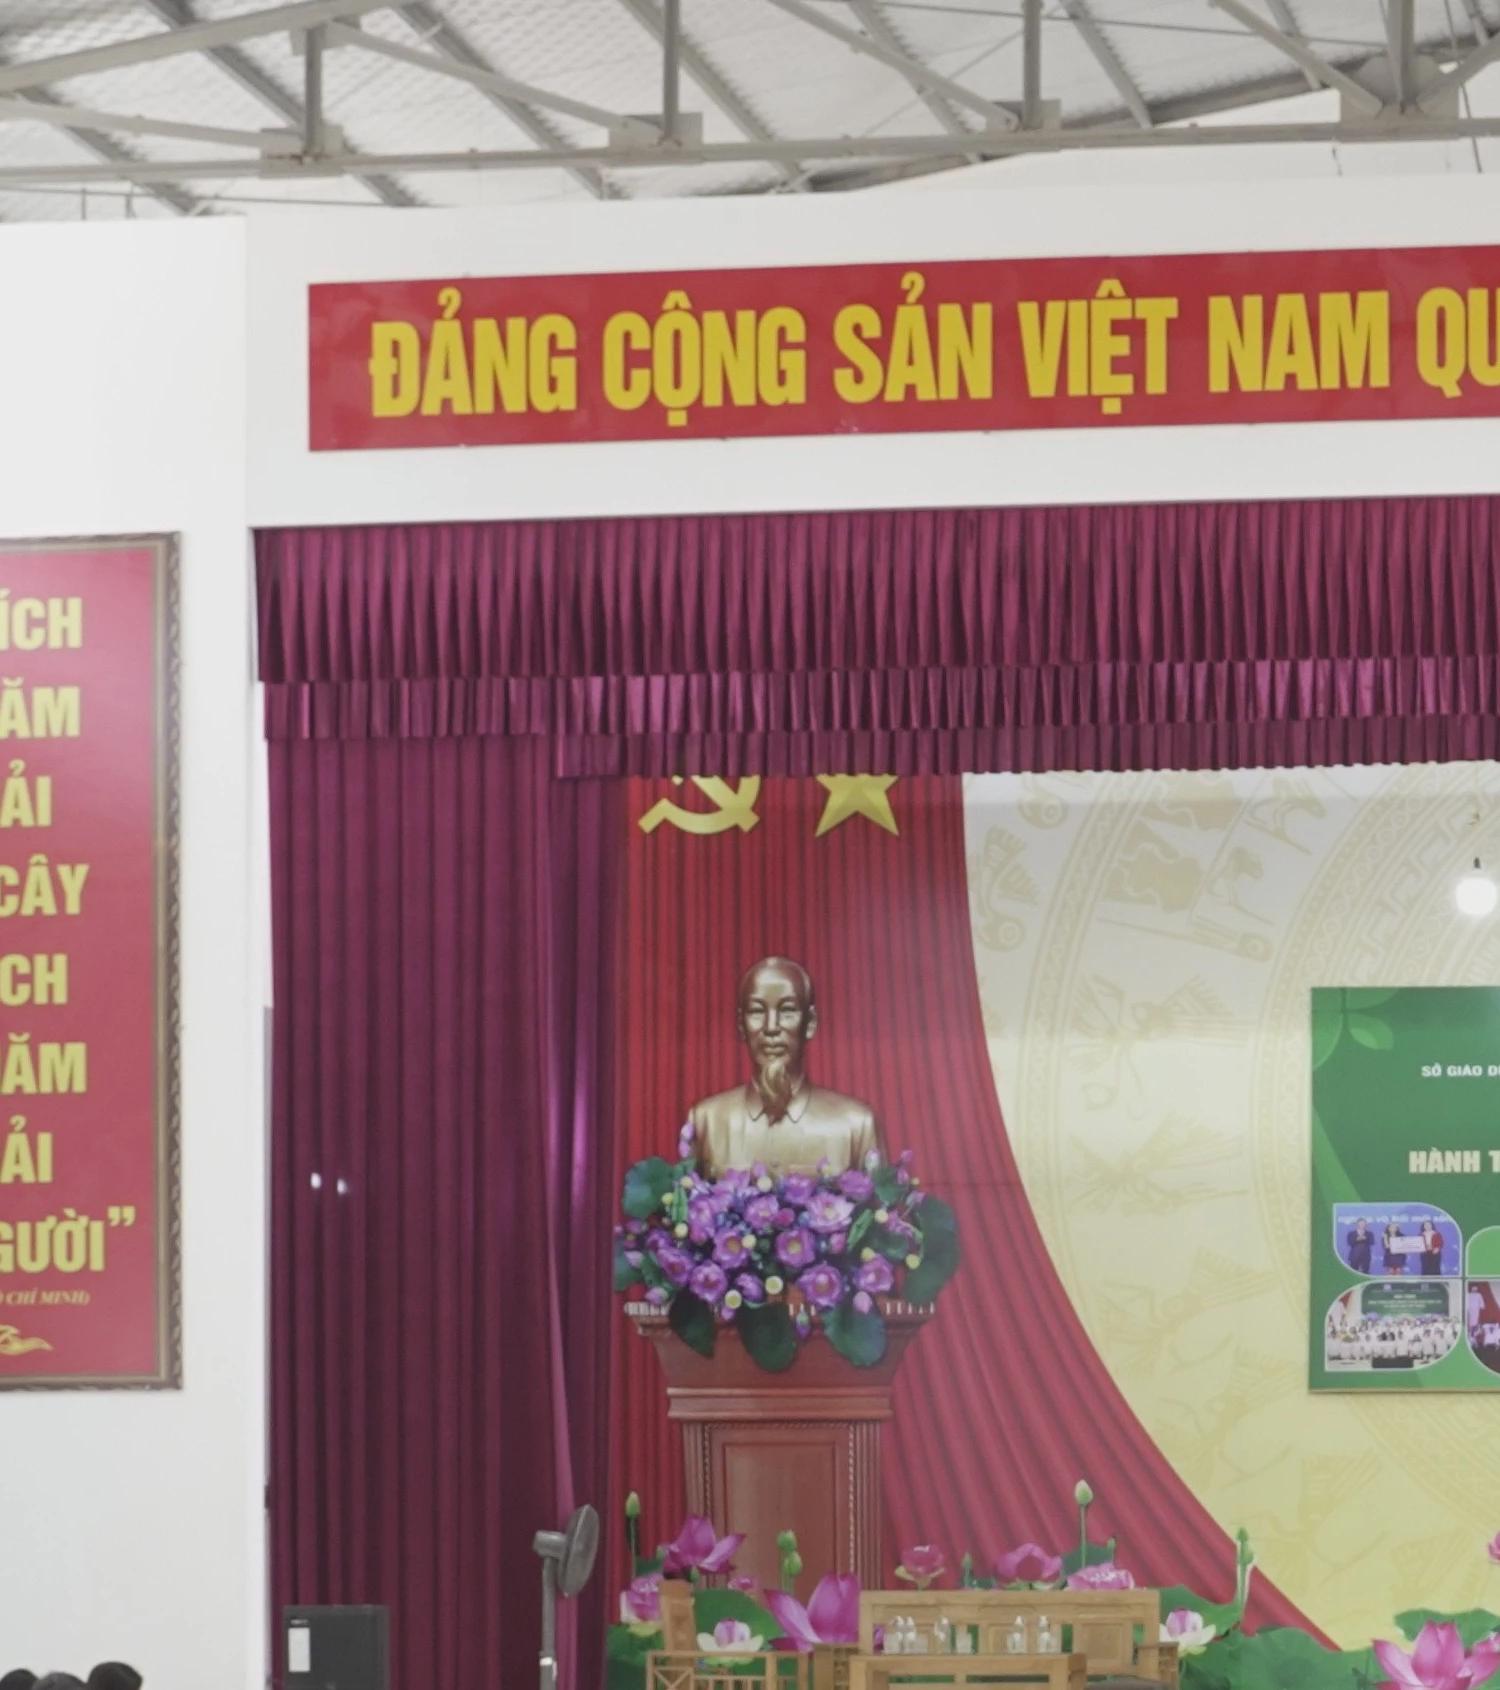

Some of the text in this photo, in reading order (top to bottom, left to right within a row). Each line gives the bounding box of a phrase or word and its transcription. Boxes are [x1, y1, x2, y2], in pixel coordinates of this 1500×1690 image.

[369, 288, 576, 416] ĐẢNG
[603, 291, 805, 425] CỘNG
[835, 273, 992, 402] SẢN
[1019, 280, 1178, 413] VIỆT
[1209, 291, 1389, 392] NAM
[1446, 1062, 1483, 1077] GIÁO
[1409, 1147, 1481, 1174] HÀNH
